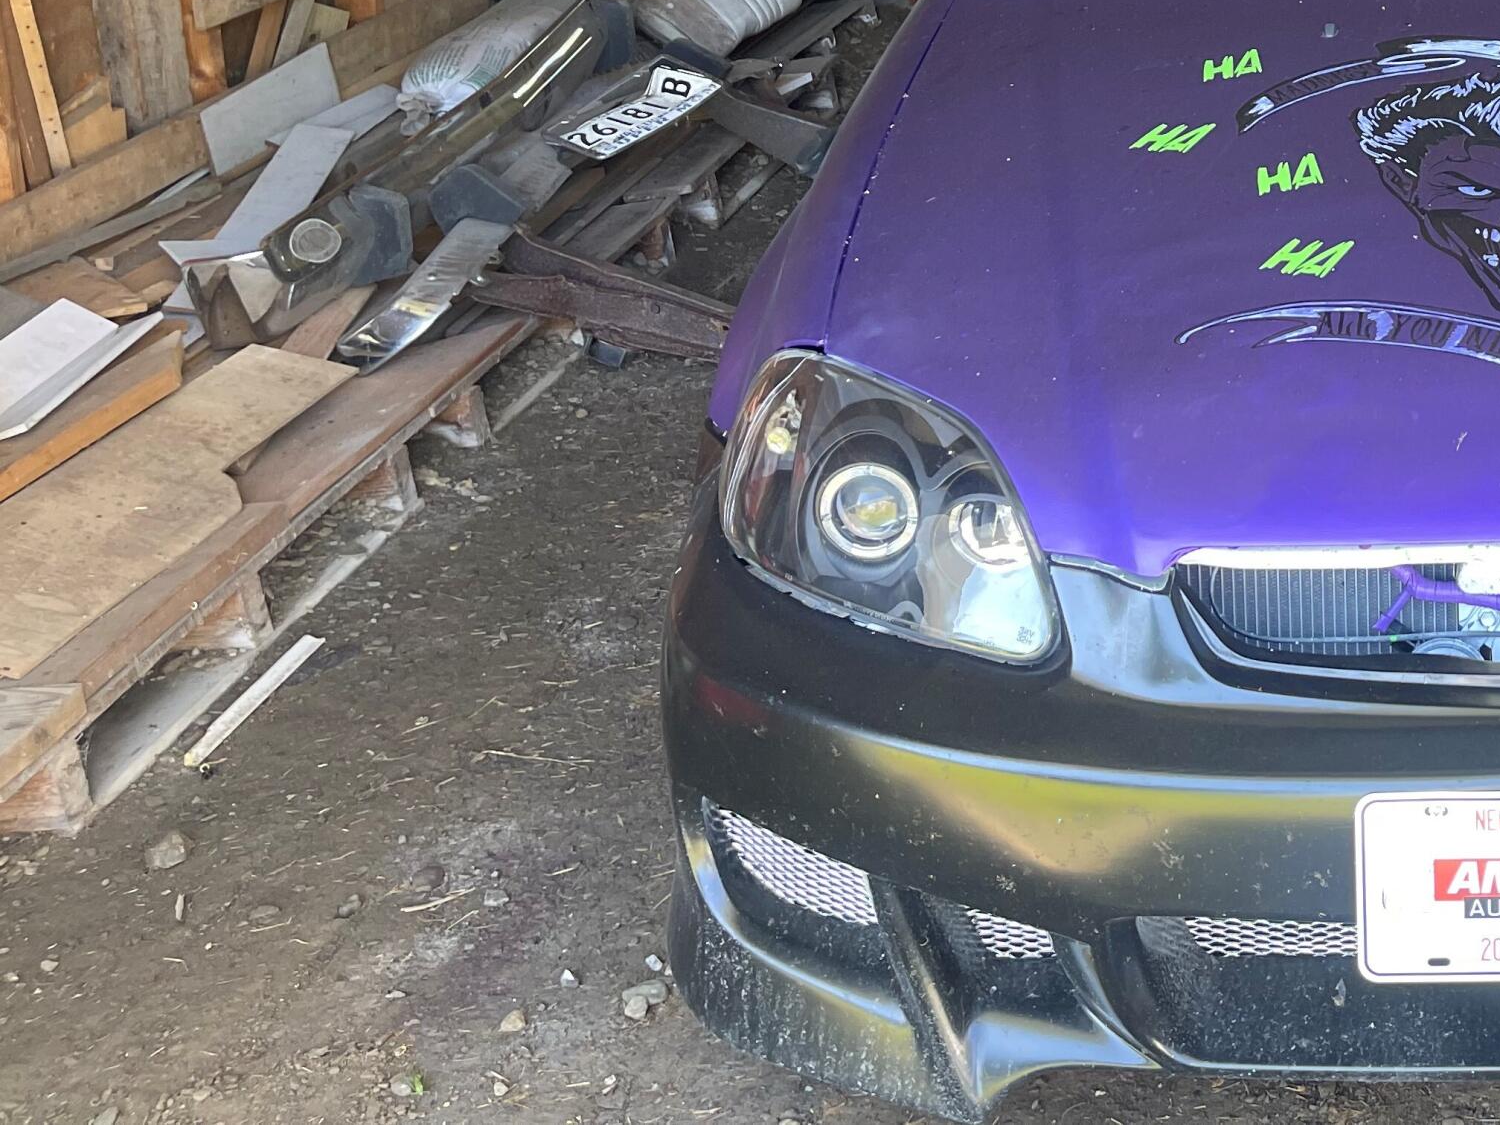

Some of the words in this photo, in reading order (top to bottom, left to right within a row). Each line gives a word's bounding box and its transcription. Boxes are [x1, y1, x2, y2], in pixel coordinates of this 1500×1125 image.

[1203, 48, 1262, 82] HA
[1130, 122, 1215, 155] HA
[1257, 153, 1323, 196] HA
[1259, 238, 1355, 278] HA
[1389, 313, 1454, 350] YOU
